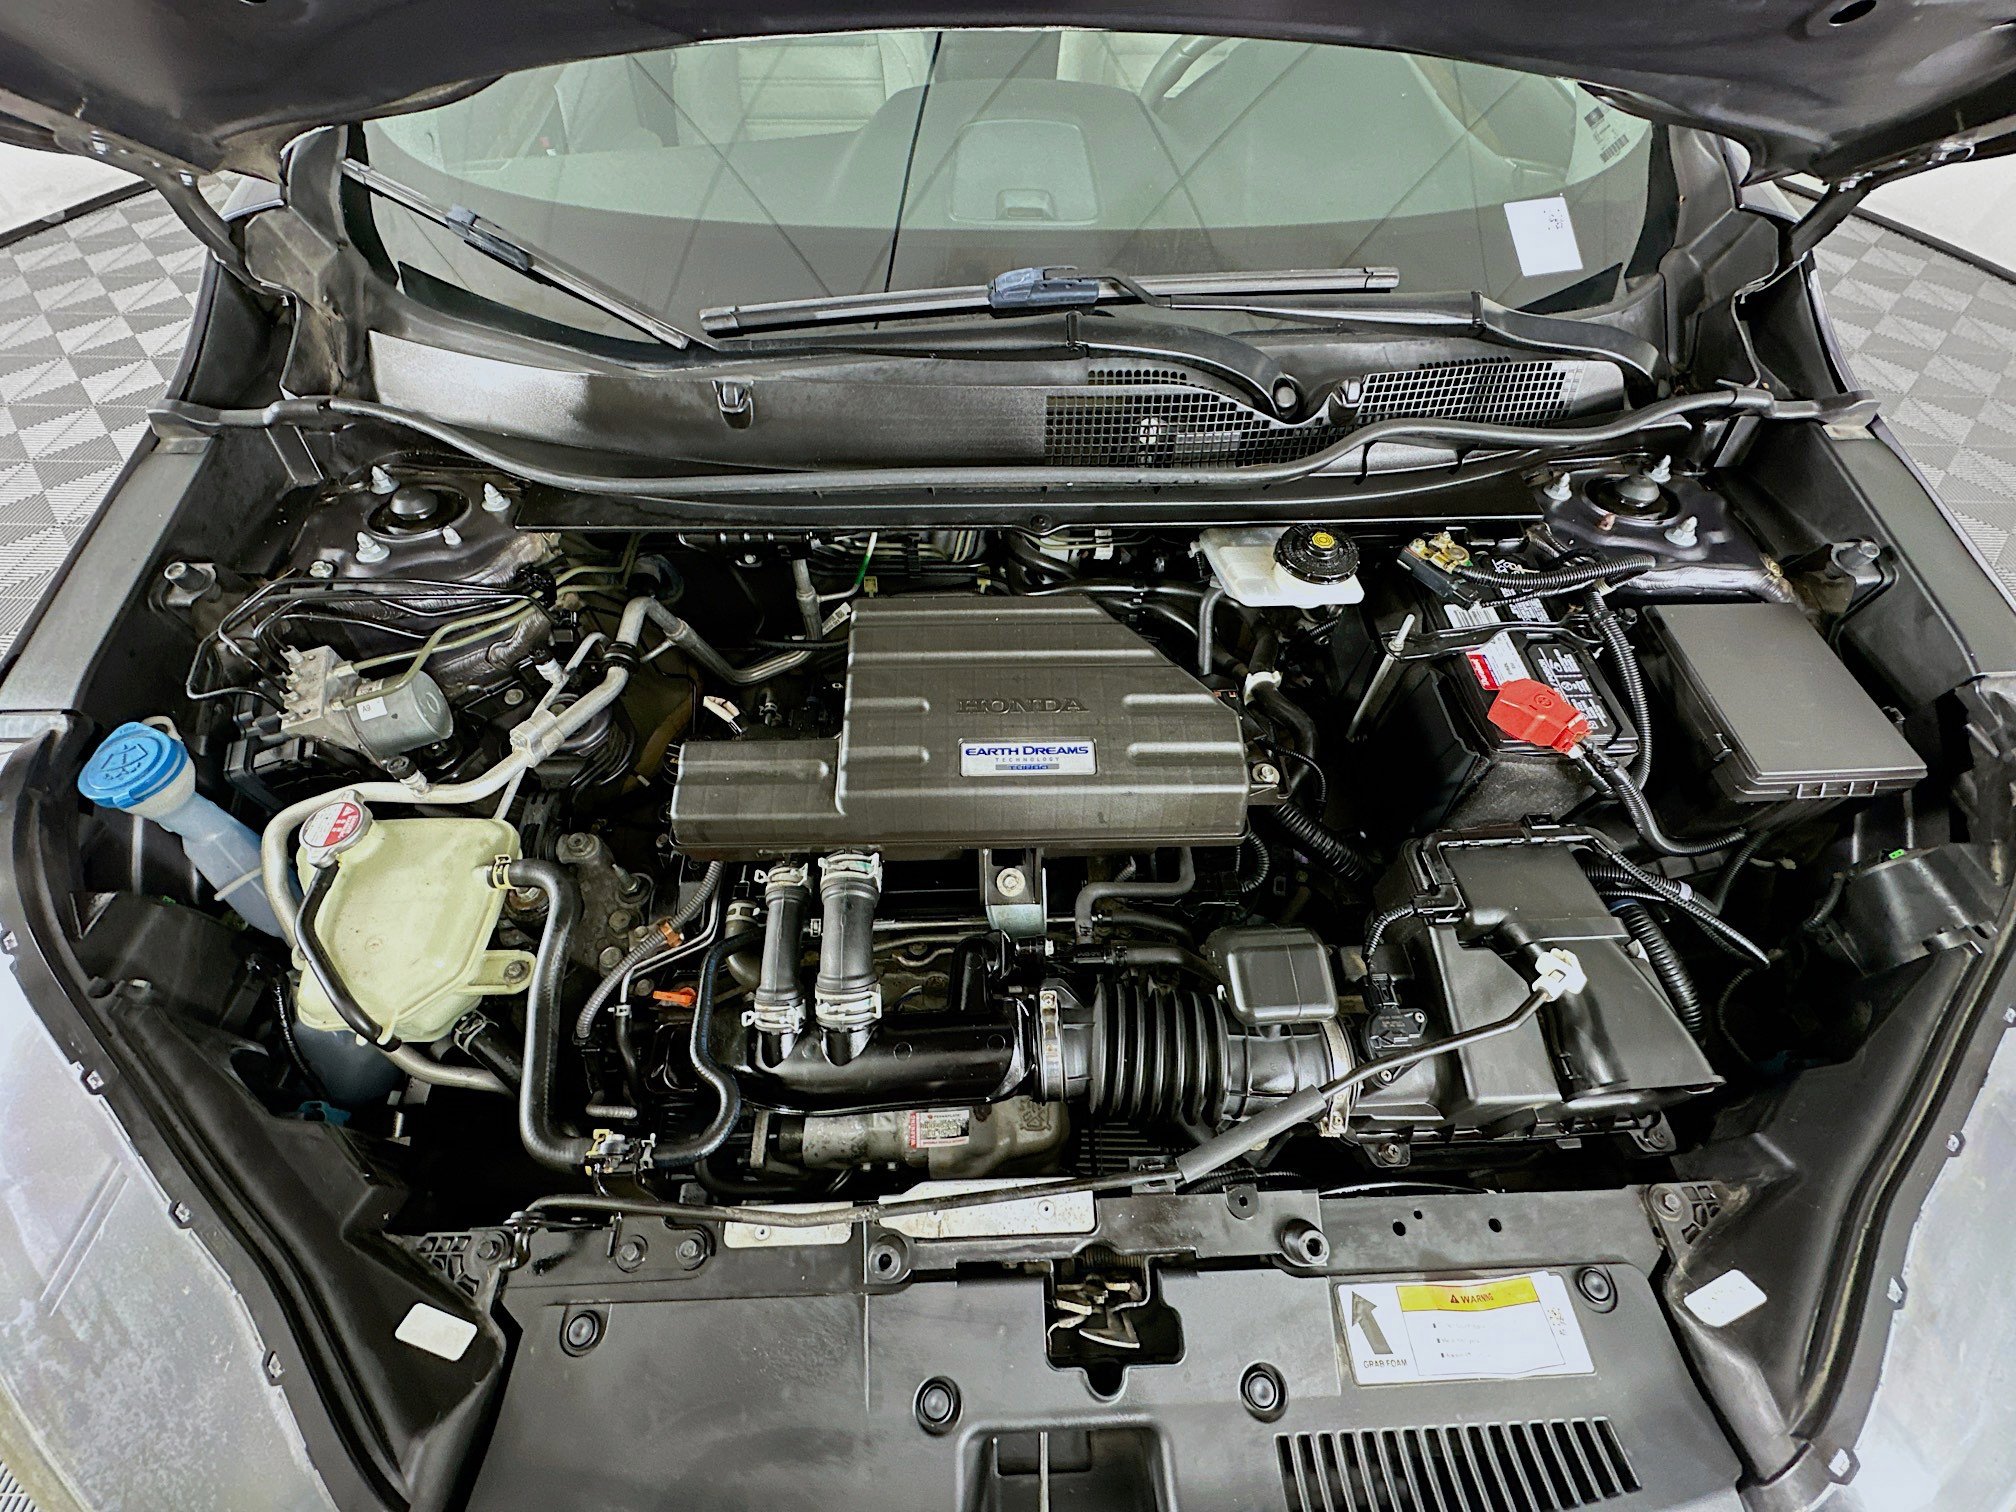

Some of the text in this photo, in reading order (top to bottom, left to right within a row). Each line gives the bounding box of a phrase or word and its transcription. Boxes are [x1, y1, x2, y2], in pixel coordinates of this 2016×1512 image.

[956, 698, 1090, 714] HONDA
[965, 745, 1089, 756] EARTH DREAMS
